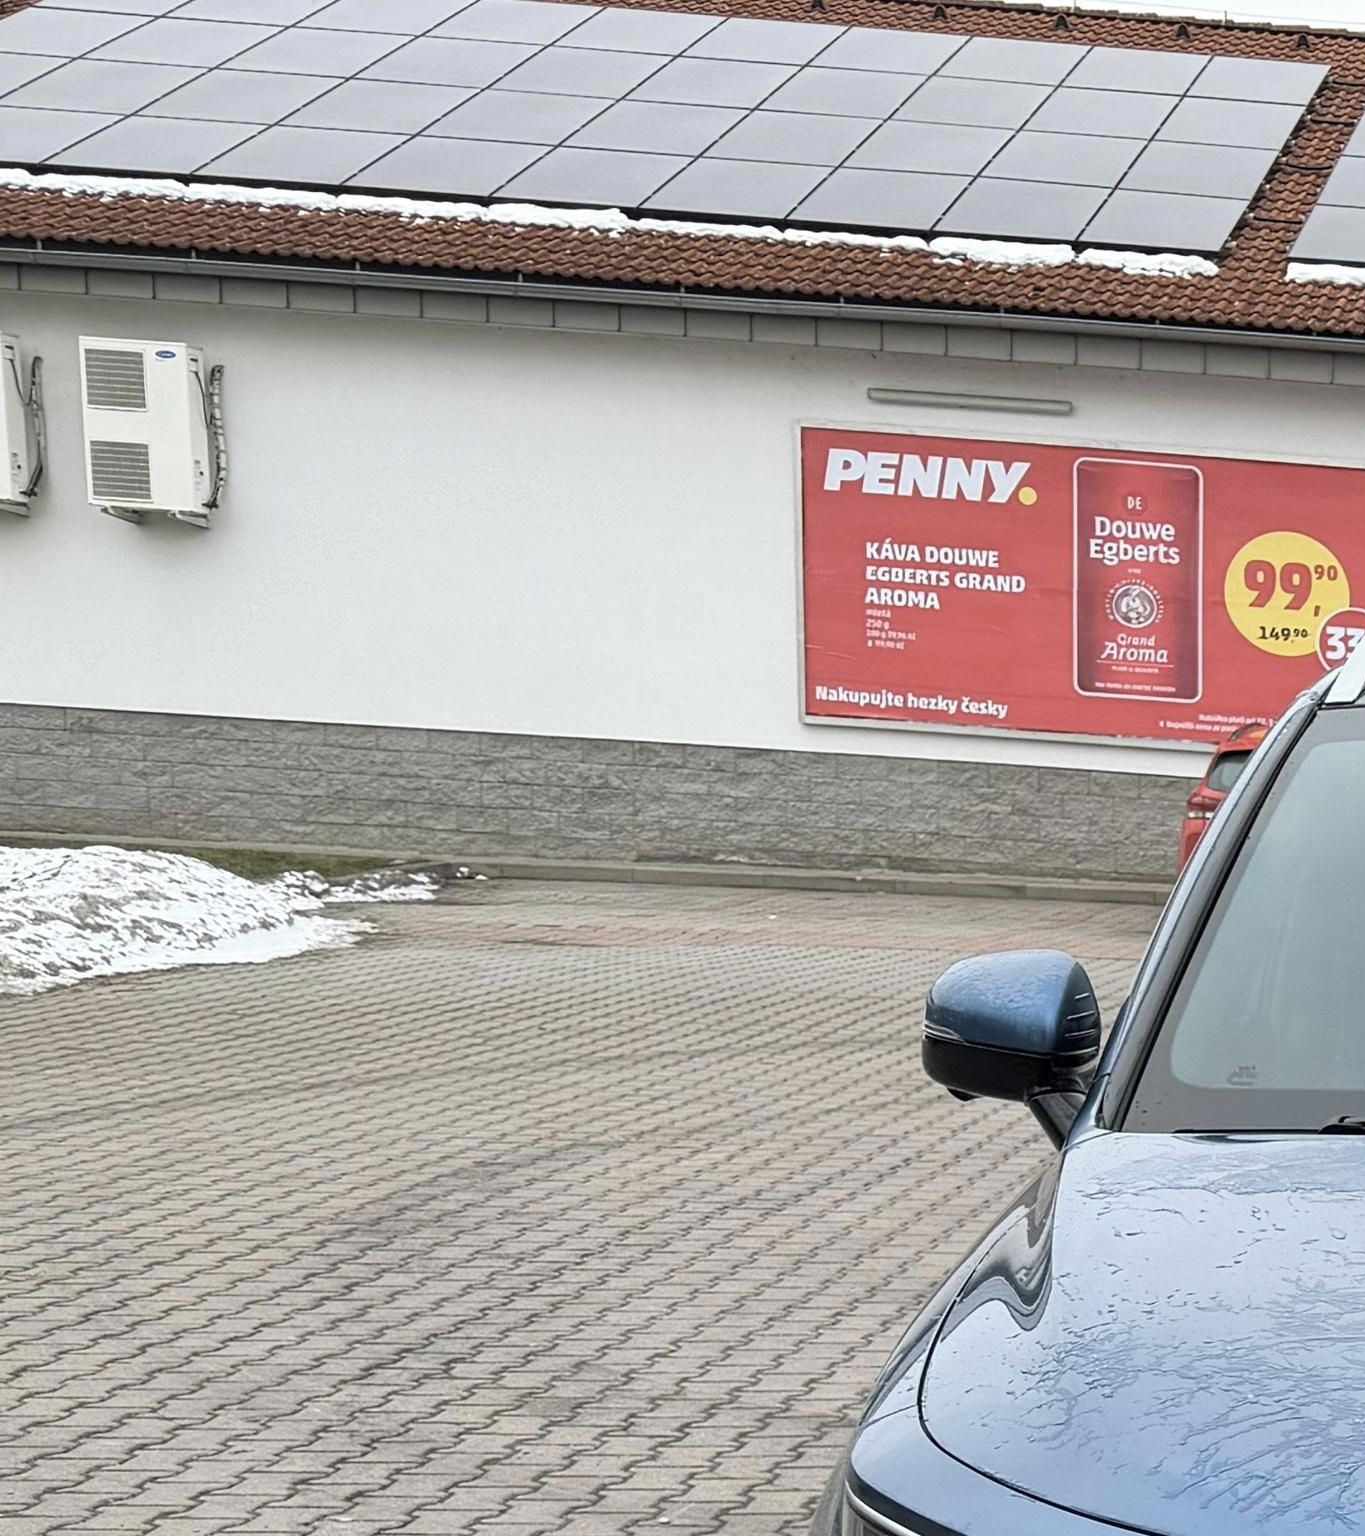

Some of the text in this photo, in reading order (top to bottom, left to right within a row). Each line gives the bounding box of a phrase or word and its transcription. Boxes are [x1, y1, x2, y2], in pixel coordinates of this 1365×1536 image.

[1094, 516, 1176, 541] Douwe
[865, 537, 1000, 568] KÁVA DOUWE
[1089, 538, 1181, 566] Egberts
[865, 566, 1026, 593] EGBERTS GRAND
[864, 587, 941, 609] AROMA
[1100, 641, 1168, 663] Aroma
[1117, 633, 1155, 646] Grand
[815, 685, 1009, 719] Nakupujte hezky česky
